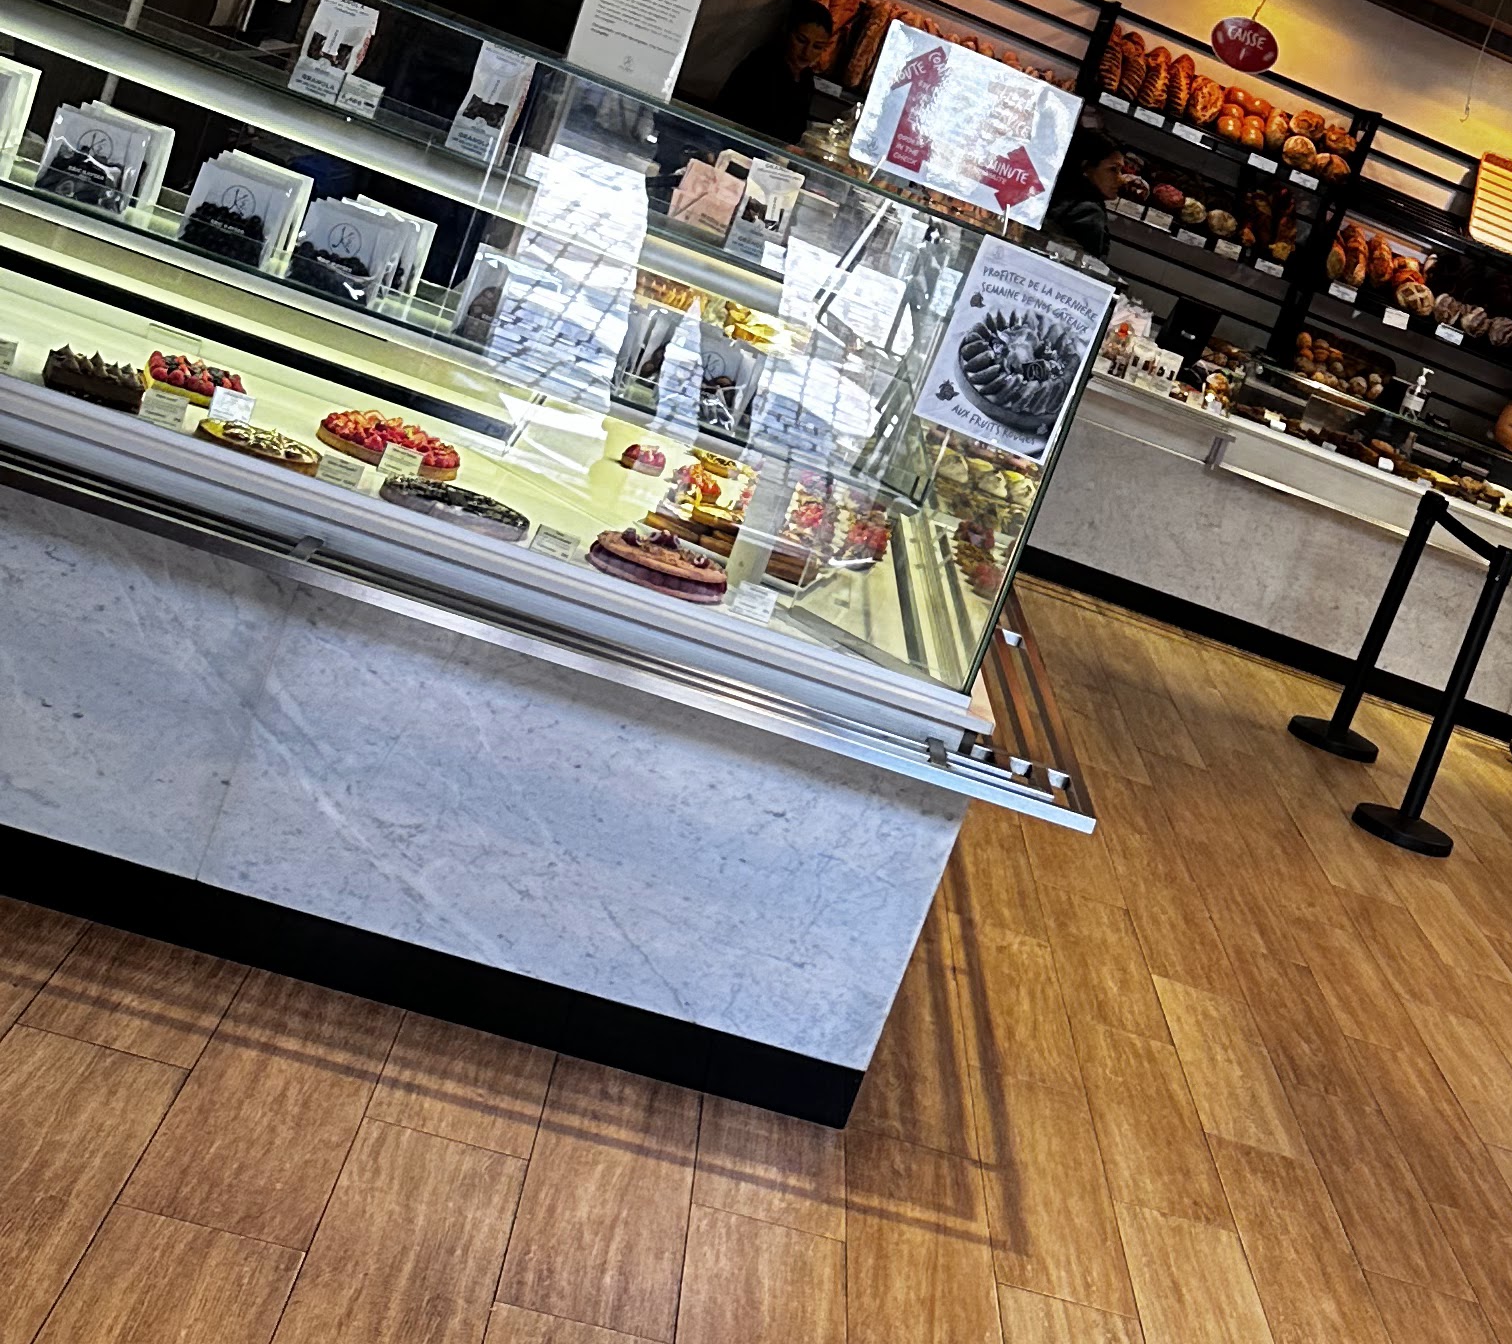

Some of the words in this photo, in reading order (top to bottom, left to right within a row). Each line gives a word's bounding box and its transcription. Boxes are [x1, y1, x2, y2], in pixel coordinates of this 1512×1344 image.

[1227, 25, 1267, 50] CAISSE
[981, 282, 1020, 301] SEMAINE
[1021, 293, 1033, 305] DE
[1034, 298, 1052, 313] NOS
[1052, 307, 1090, 334] GÂTEAUX
[982, 265, 1026, 286] PROFITEZ
[1028, 279, 1040, 291] DE
[1041, 284, 1053, 296] LA
[1055, 292, 1099, 323] DERNIÈRE
[951, 404, 970, 419] AUX
[968, 413, 1001, 435] FRUITS
[1001, 428, 1035, 445] ROUGES
